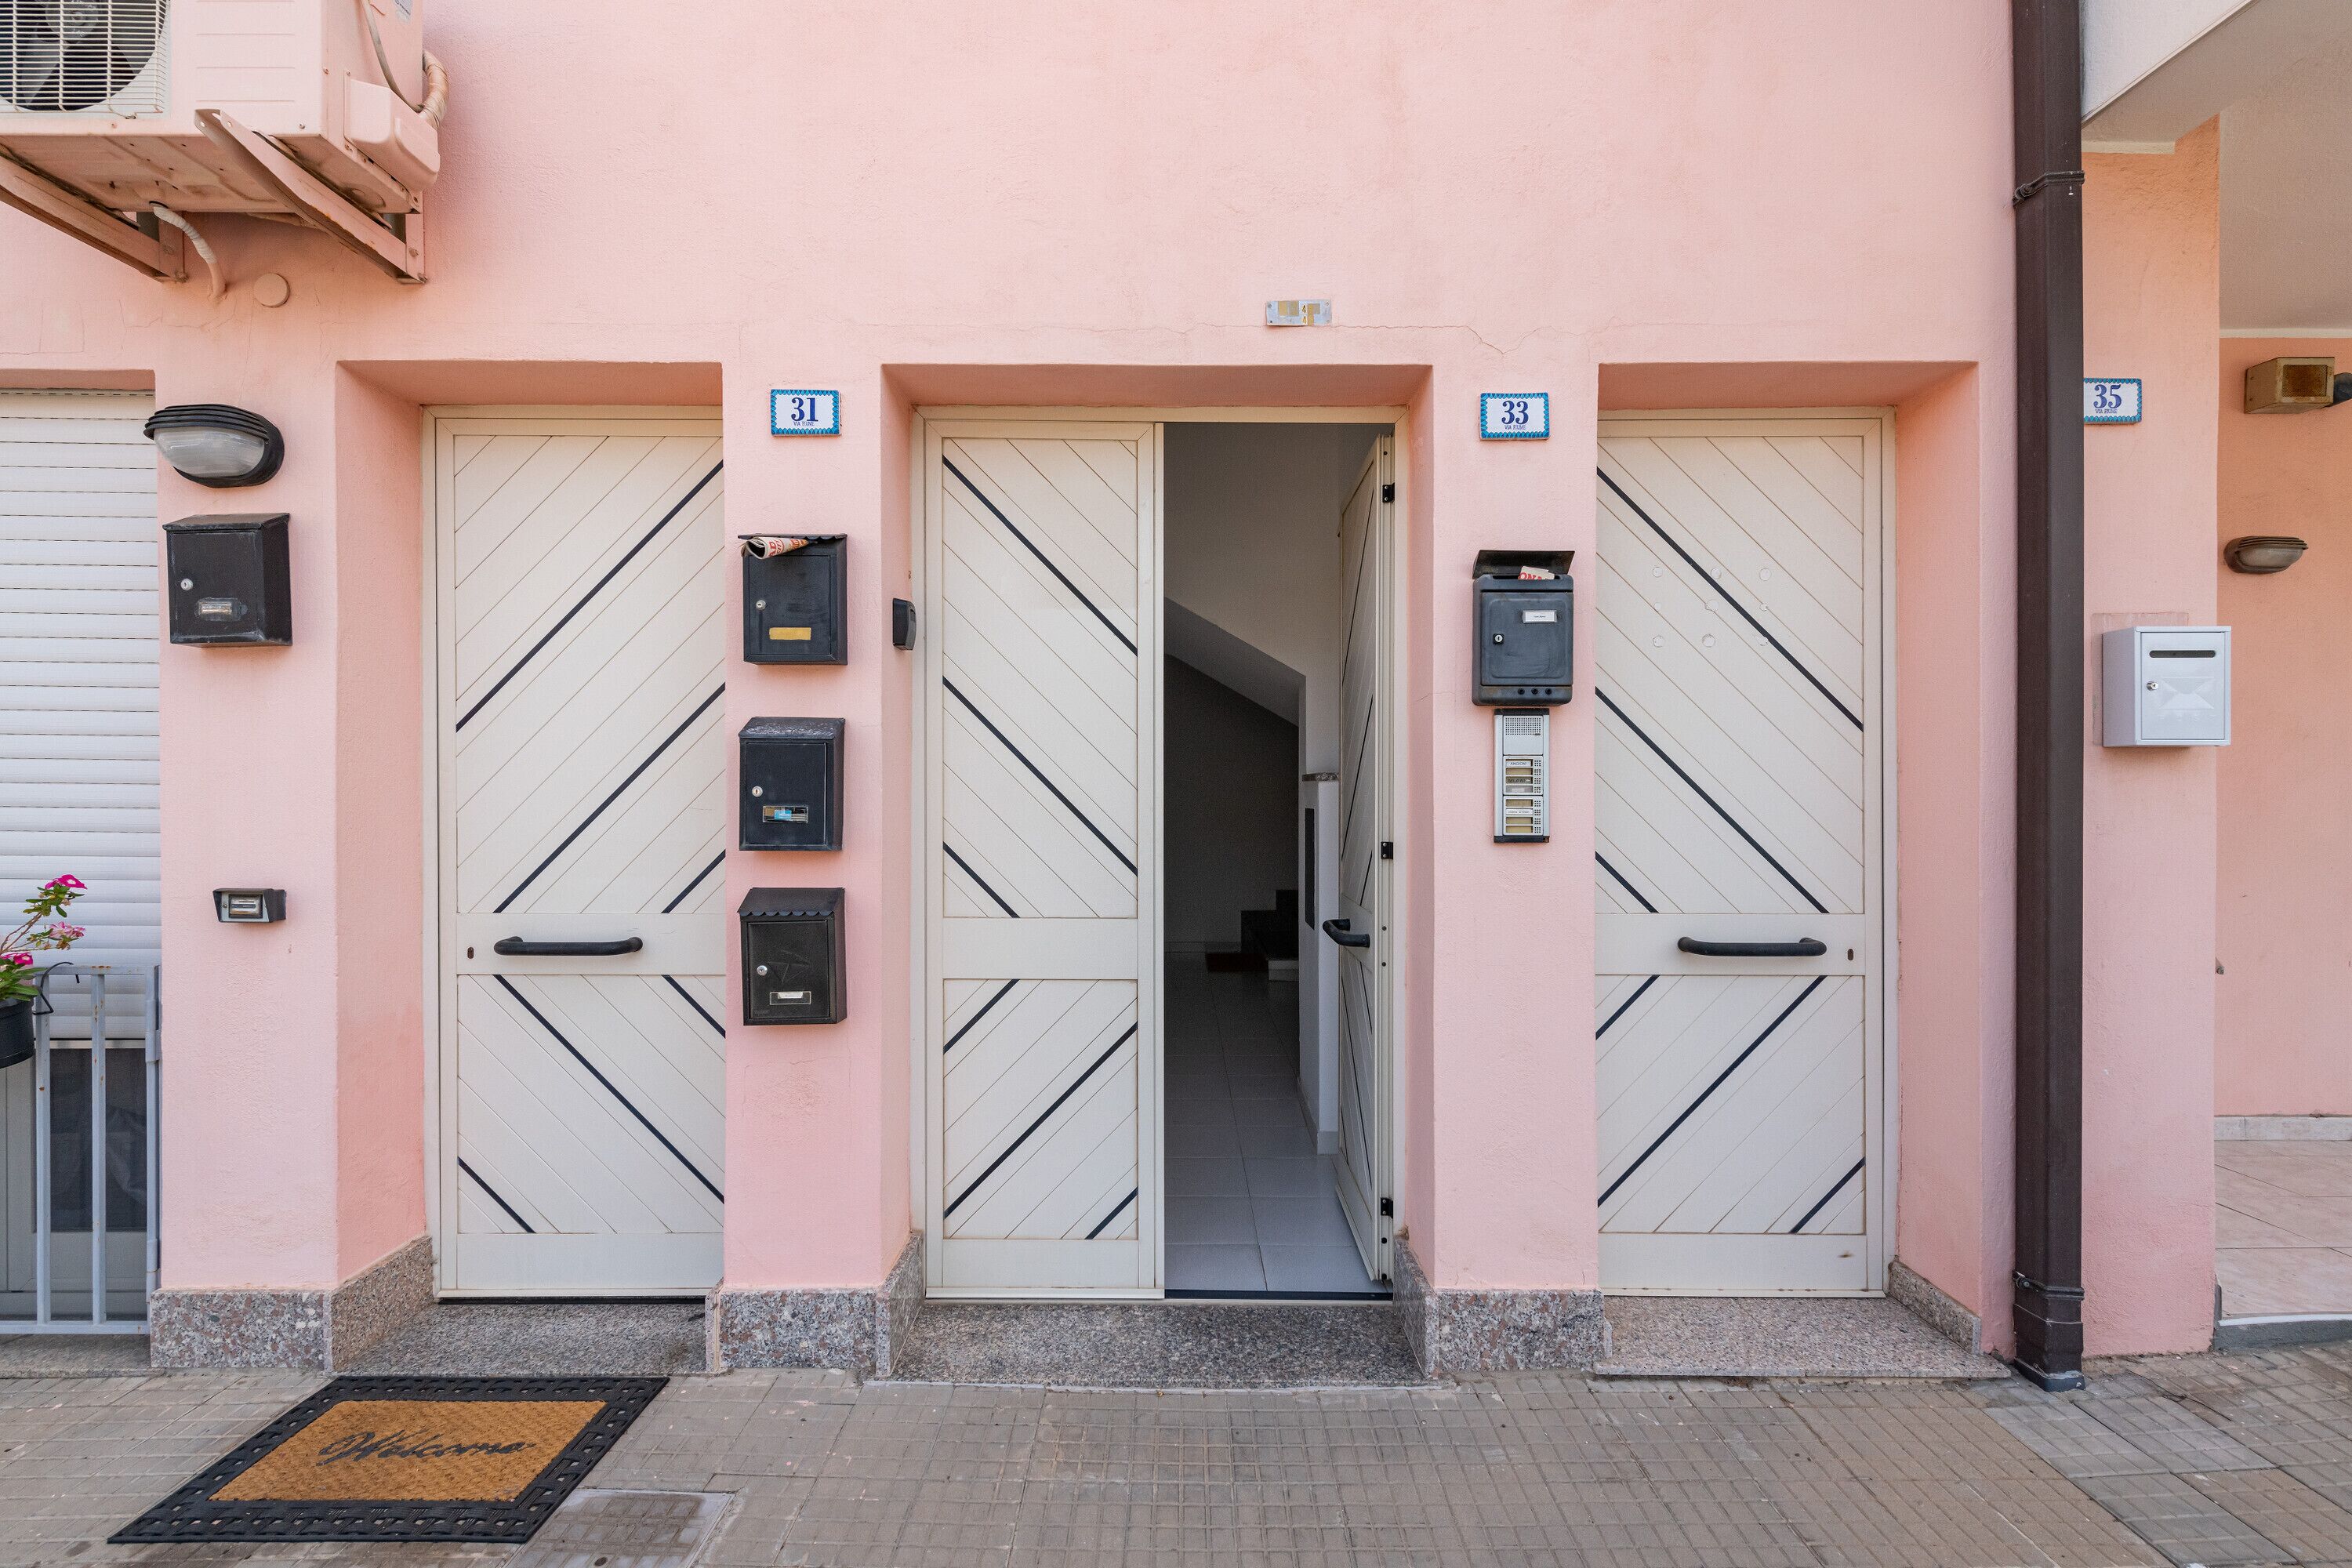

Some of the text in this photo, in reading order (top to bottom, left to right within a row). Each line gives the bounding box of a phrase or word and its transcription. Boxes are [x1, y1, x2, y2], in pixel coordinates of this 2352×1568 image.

[2093, 384, 2122, 408] 35
[791, 397, 818, 422] 31
[1501, 401, 1529, 424] 33
[315, 1429, 536, 1466] Welcome
